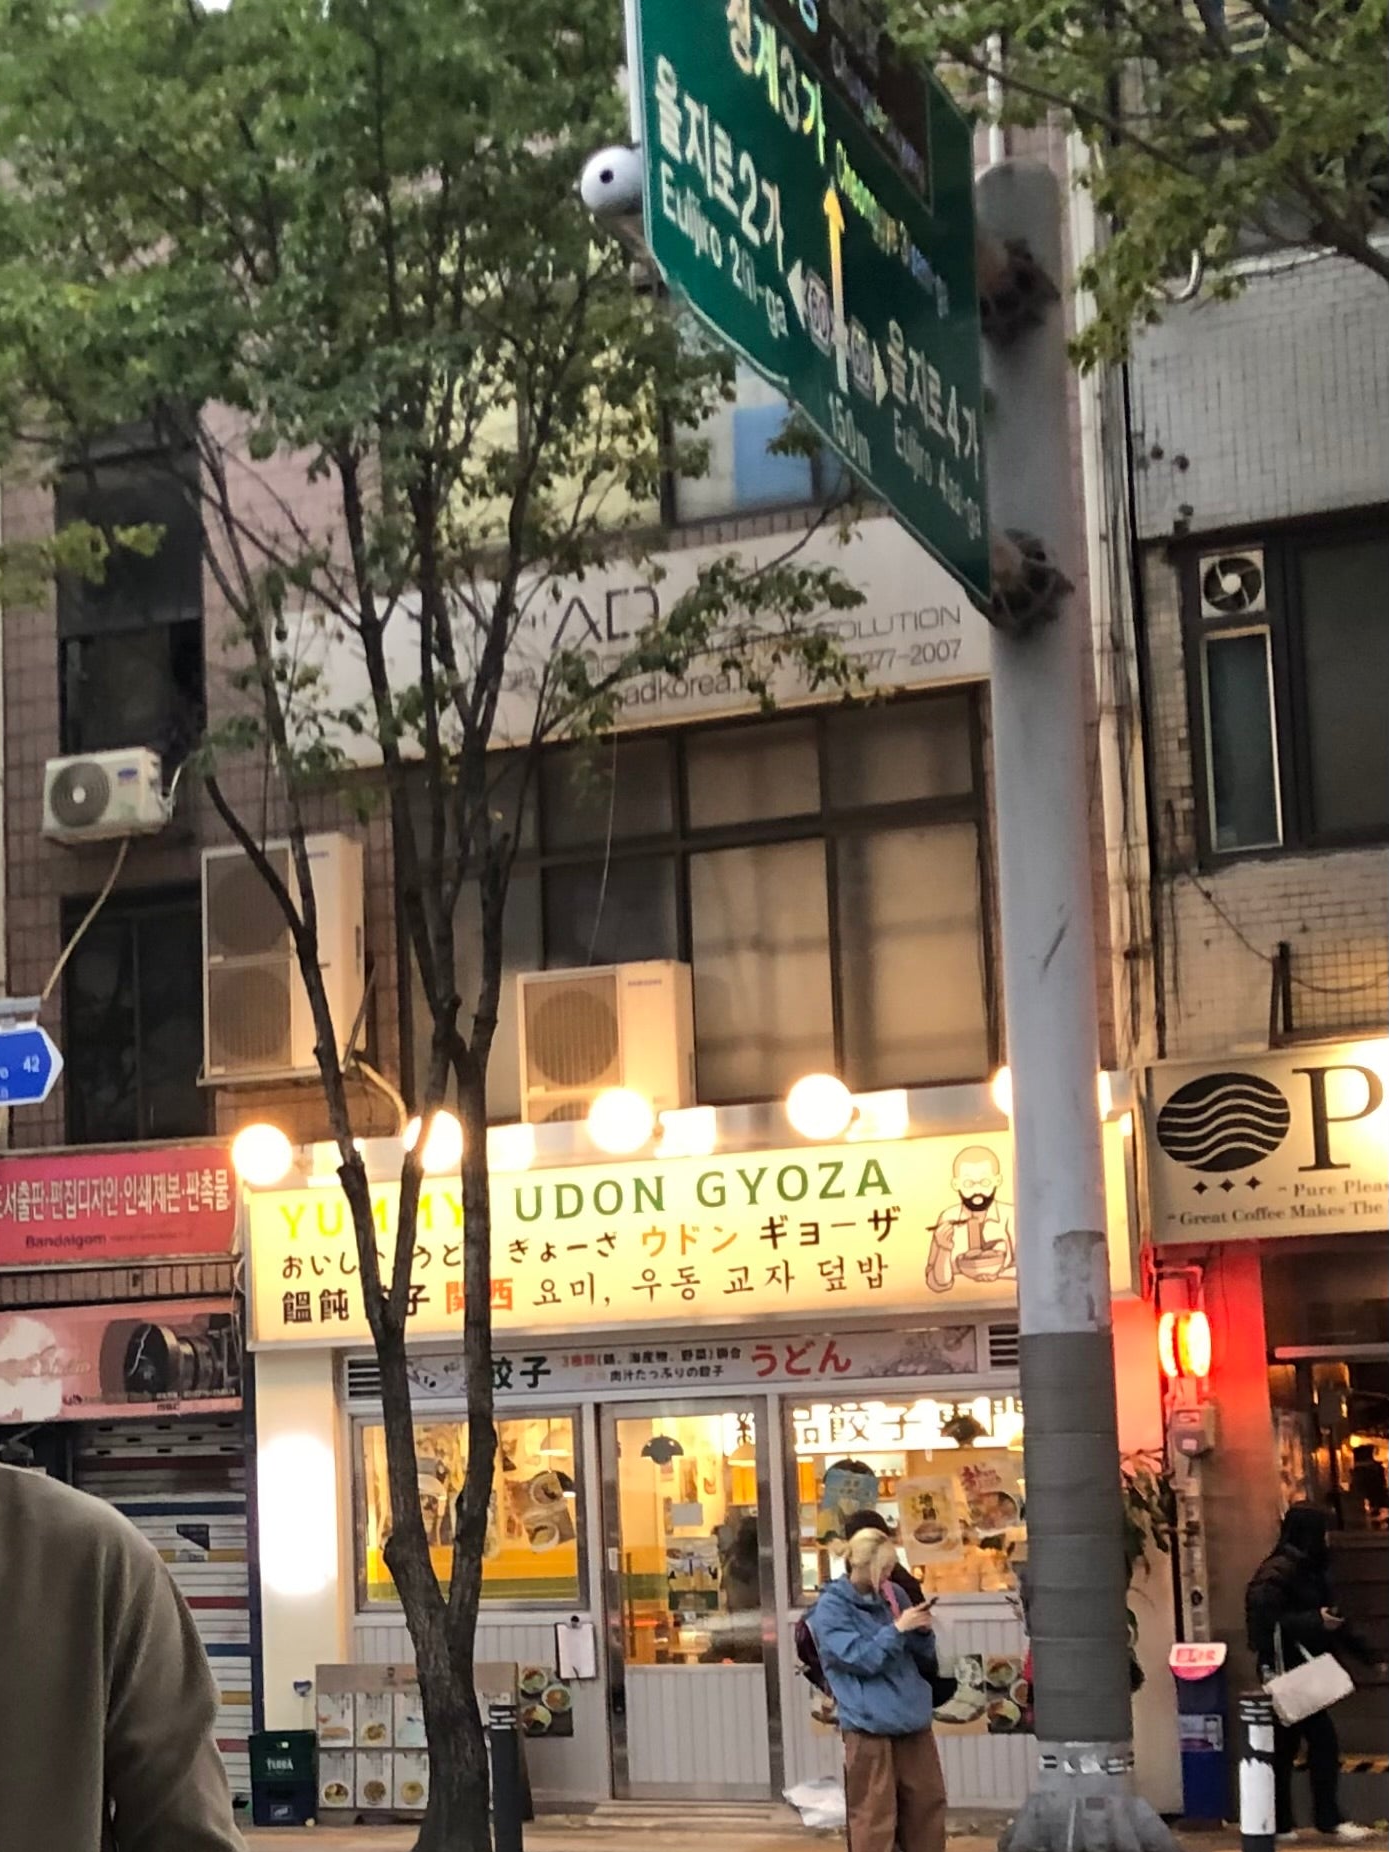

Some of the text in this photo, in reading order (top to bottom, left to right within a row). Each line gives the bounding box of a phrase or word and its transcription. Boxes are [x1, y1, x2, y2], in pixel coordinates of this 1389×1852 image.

[655, 54, 785, 274] 을지로2가
[660, 160, 723, 269] Euljiro
[887, 318, 980, 482] 을지로4가
[22, 1054, 40, 1073] 42
[514, 1175, 666, 1222] UDON
[695, 1158, 893, 1208] GYOZA
[1179, 1201, 1384, 1226] Great Coffee Makes The
[1293, 1182, 1338, 1198] Pure
[641, 1223, 739, 1258] ウドン
[759, 1205, 902, 1251] ギョーザ
[380, 1284, 431, 1318] 子
[531, 1271, 611, 1307] 요미,
[630, 1265, 702, 1301] 우동
[723, 1259, 795, 1296] 교자
[817, 1252, 890, 1294] 덮밥
[750, 1340, 852, 1378] うどん
